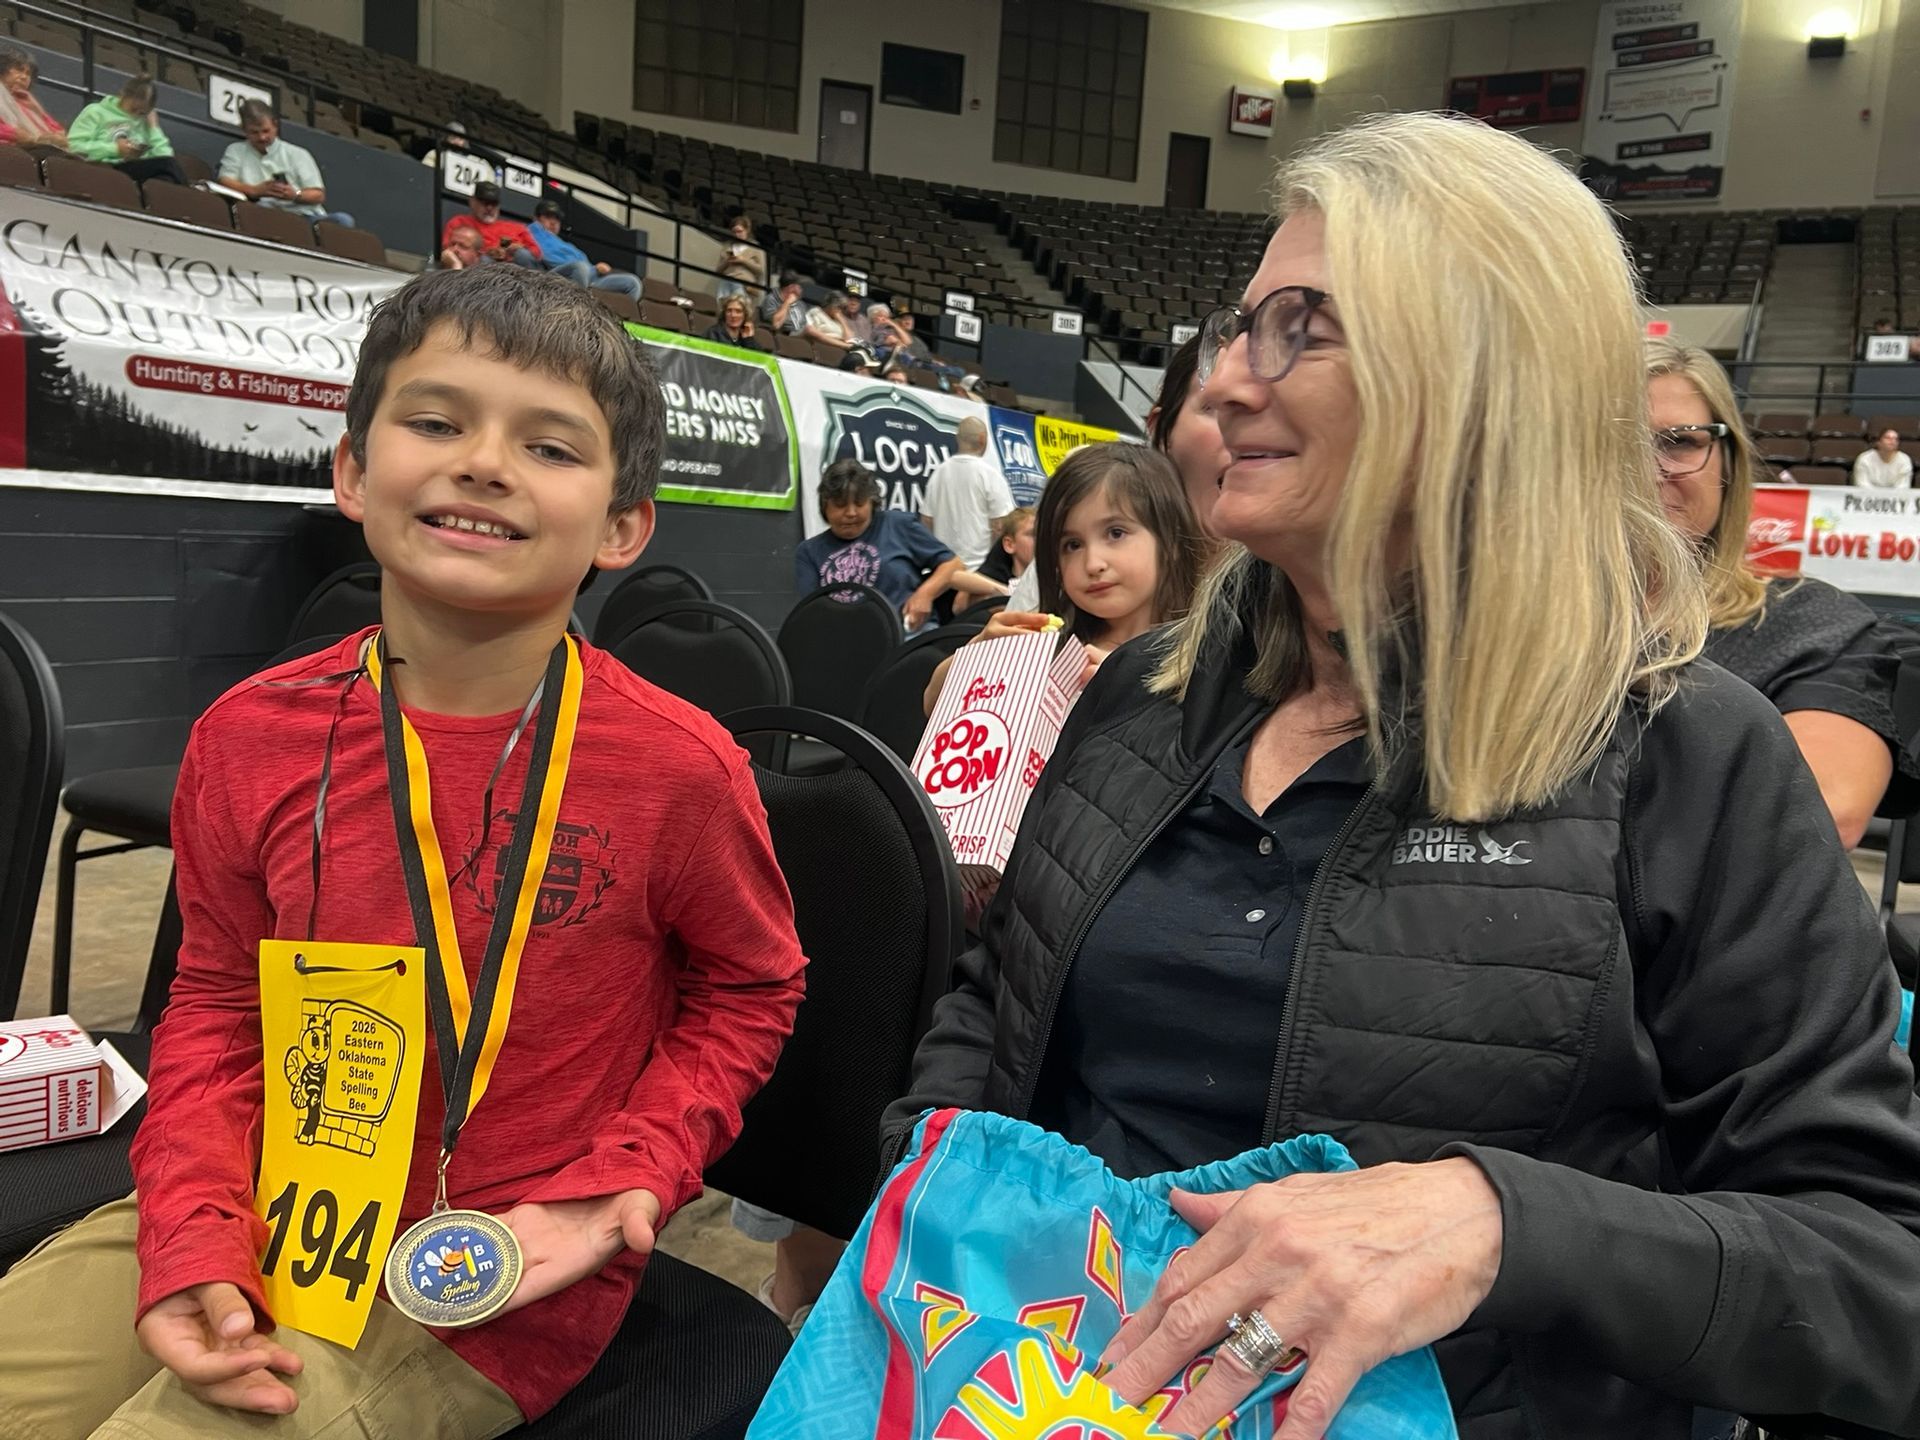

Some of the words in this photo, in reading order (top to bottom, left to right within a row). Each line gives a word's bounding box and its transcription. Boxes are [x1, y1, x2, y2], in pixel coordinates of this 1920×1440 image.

[2, 219, 264, 308] CANYON
[135, 359, 214, 392] Hunting
[218, 370, 235, 390] &
[239, 373, 299, 401] Fishing
[689, 386, 764, 420] MONEY
[711, 416, 761, 446] MISS
[1041, 424, 1057, 448] We
[1844, 493, 1906, 514] PROUDLY
[1808, 528, 1870, 560] LOVE
[1878, 531, 1920, 562] BO
[963, 676, 1006, 710] fresh
[932, 719, 989, 763] POP
[924, 746, 1003, 794] CORN
[950, 834, 987, 854] CRISP
[1392, 843, 1476, 865] BAUER
[352, 1020, 376, 1034] 2026
[345, 1034, 384, 1050] Eastern
[338, 1049, 386, 1066] Oklahoma
[348, 1066, 374, 1080] State
[77, 1079, 92, 1127] delicious
[341, 1080, 378, 1100] Spelling
[58, 1079, 73, 1133] nutritious
[349, 1098, 366, 1111] Bee
[261, 1181, 382, 1302] 194
[440, 1279, 480, 1300] Spelling
